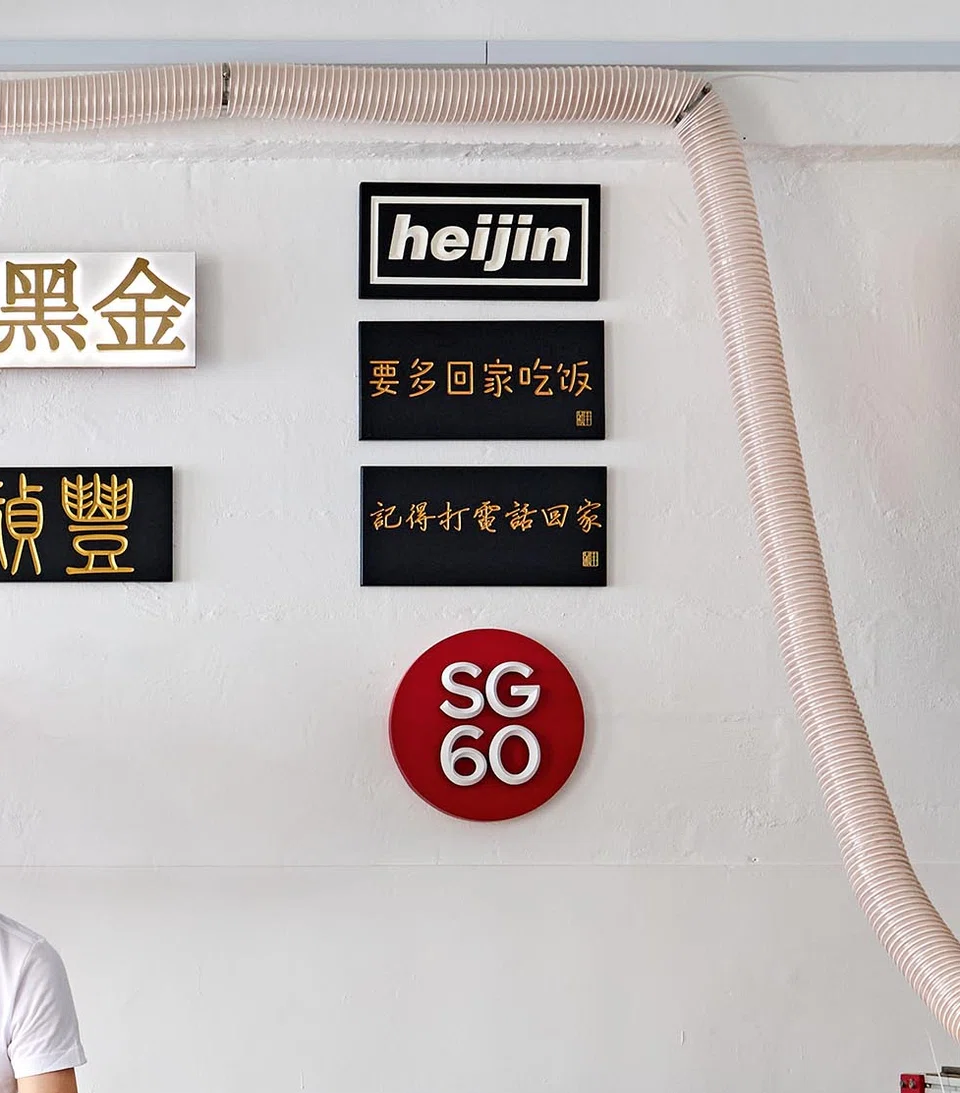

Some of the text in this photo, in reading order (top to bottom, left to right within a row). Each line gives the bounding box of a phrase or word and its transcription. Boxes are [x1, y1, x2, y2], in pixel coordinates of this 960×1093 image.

[388, 214, 571, 272] heijin
[369, 357, 593, 398] 要多回家吃饭
[370, 498, 602, 533] 記得打電話回家
[439, 661, 541, 719] SG
[439, 724, 541, 786] 60
